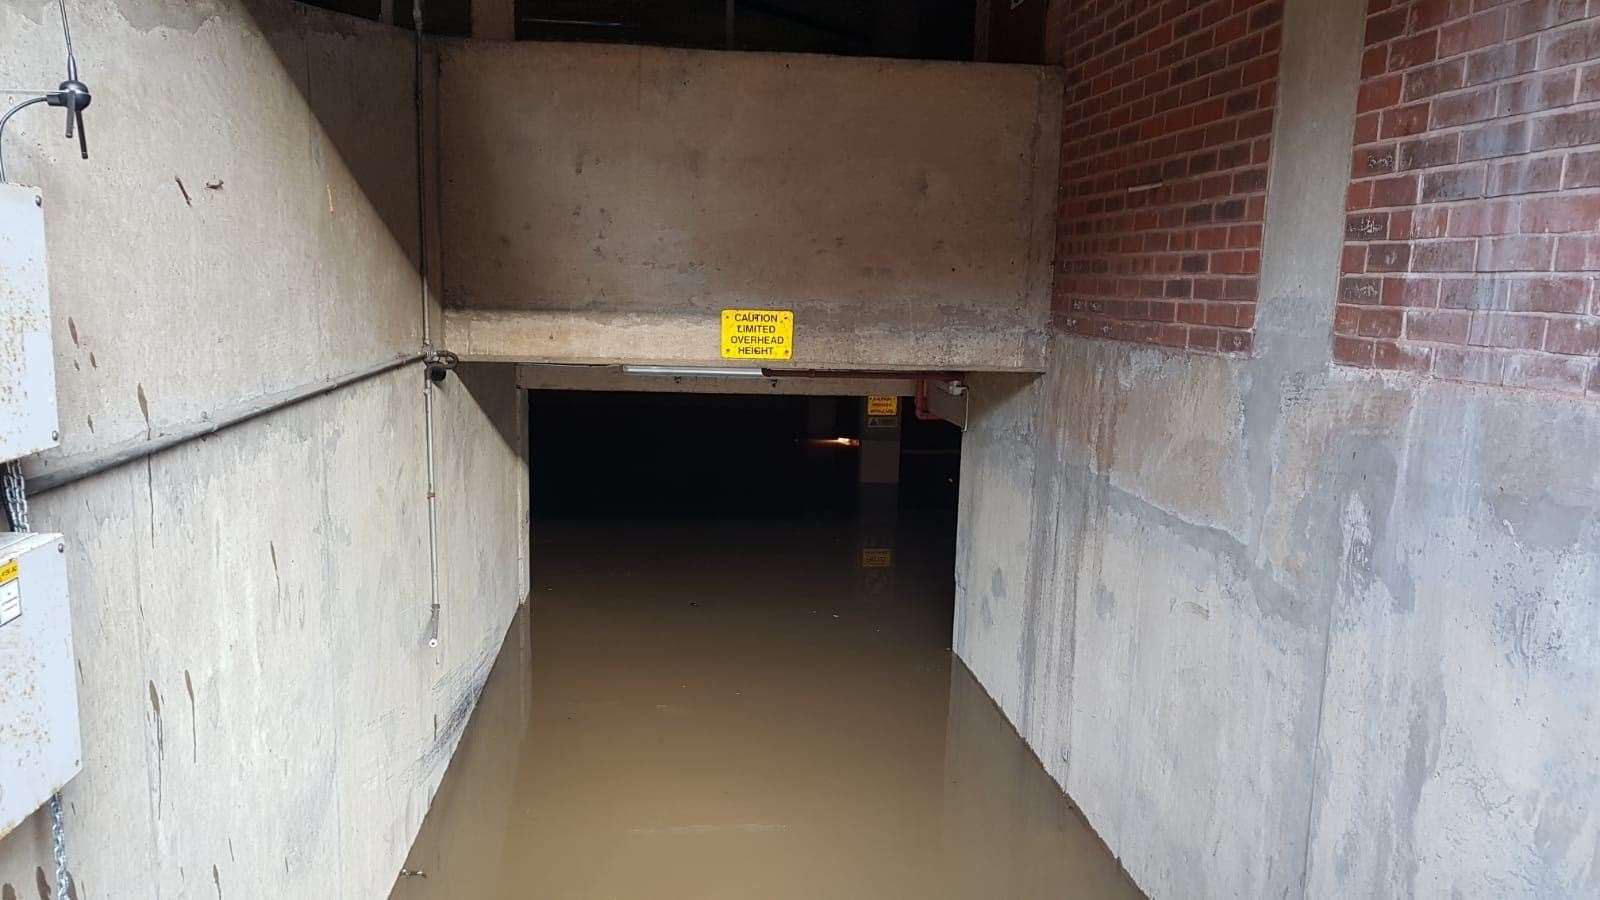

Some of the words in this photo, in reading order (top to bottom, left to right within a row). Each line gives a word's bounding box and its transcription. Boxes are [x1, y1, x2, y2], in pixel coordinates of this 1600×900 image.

[734, 313, 778, 323] CAUTION
[737, 325, 776, 334] LIMITED
[730, 335, 784, 345] OVERHEAD
[738, 346, 774, 356] HEIGHT
